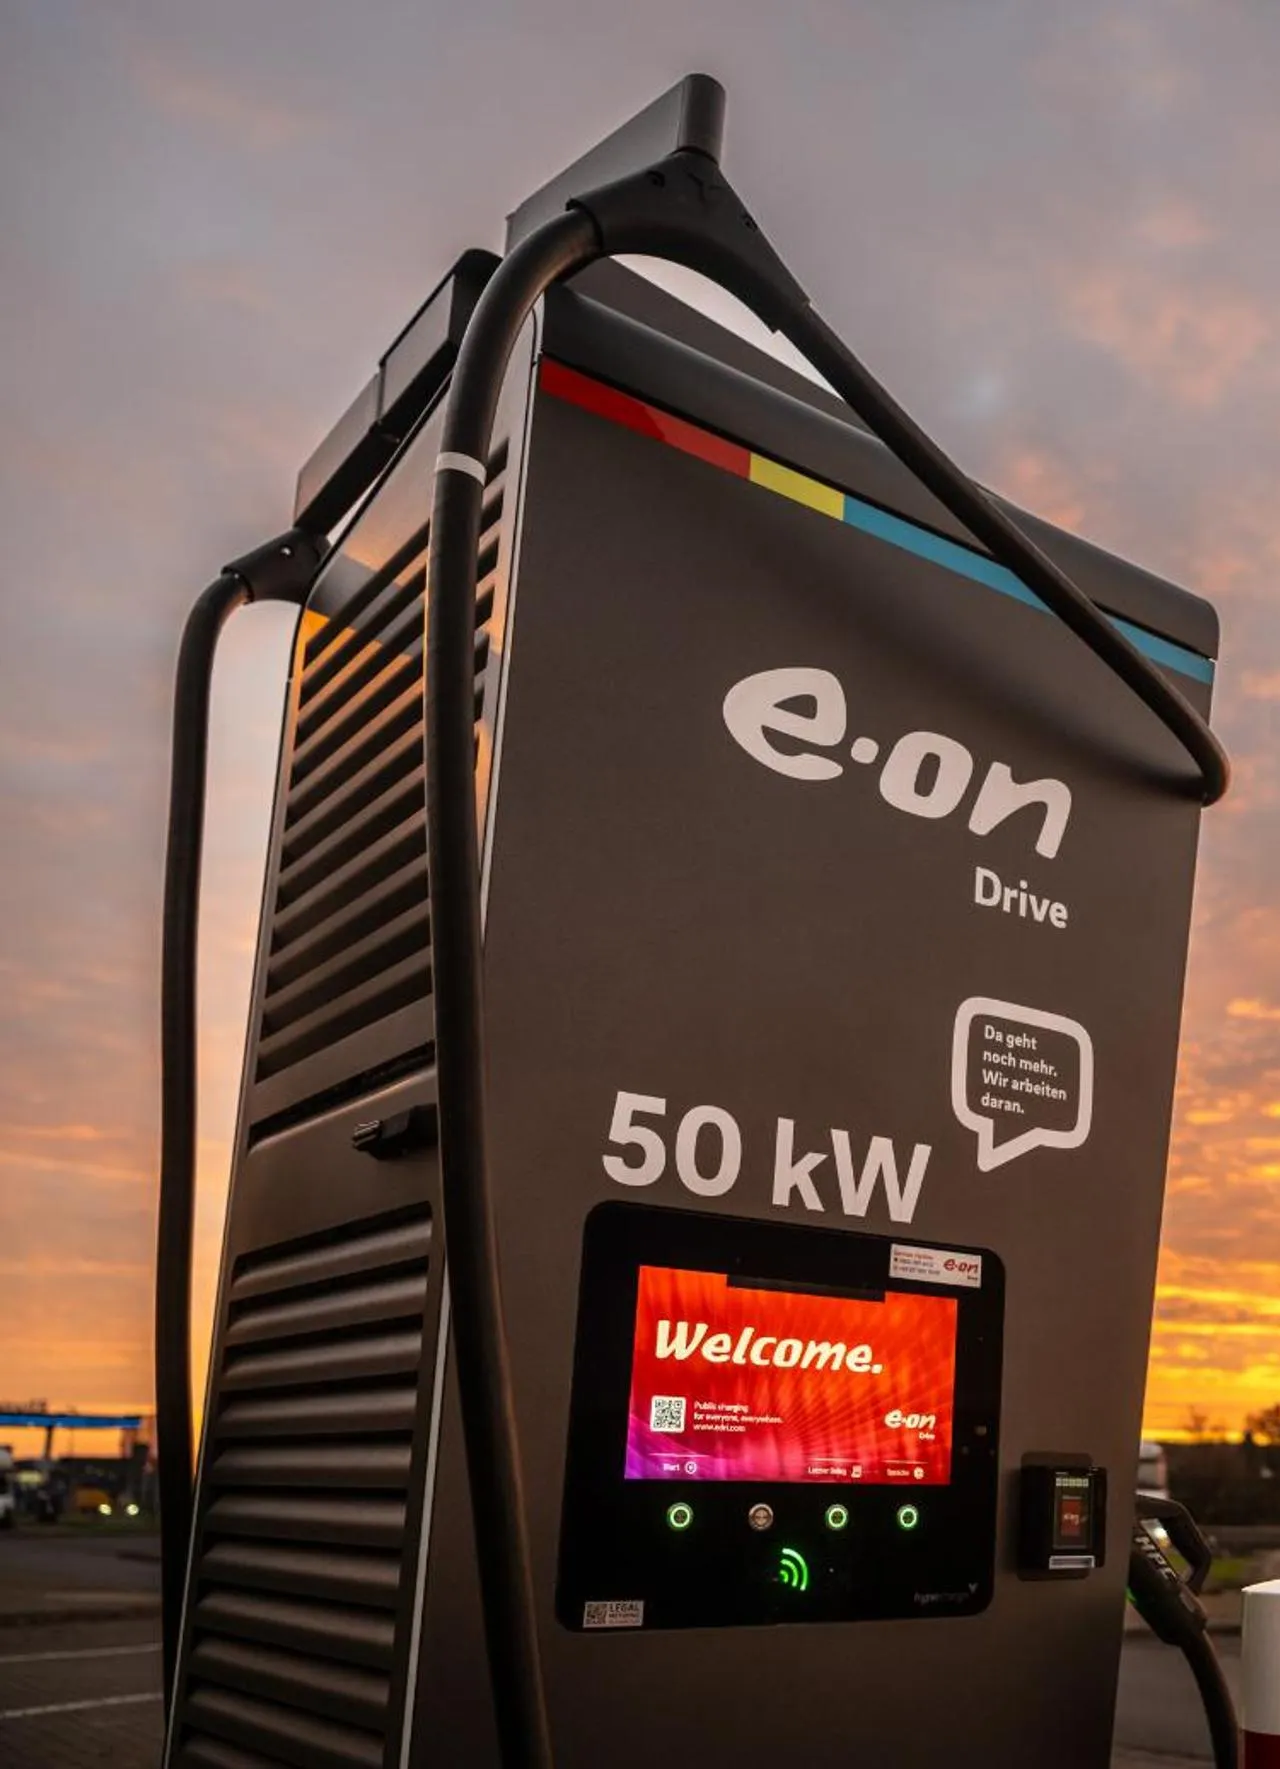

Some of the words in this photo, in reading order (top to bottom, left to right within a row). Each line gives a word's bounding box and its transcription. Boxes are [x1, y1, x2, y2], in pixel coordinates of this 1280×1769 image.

[974, 866, 1069, 929] Drive
[984, 1024, 1003, 1043] Da
[1006, 1033, 1038, 1050] geht
[983, 1050, 1016, 1068] noch
[1020, 1059, 1058, 1077] mehr.
[982, 1068, 1008, 1088] Wir
[1011, 1078, 1067, 1101] arbeiten
[981, 1092, 1024, 1114] daran.
[602, 1090, 742, 1197] 50
[772, 1117, 932, 1224] kW
[655, 1319, 883, 1374] Welcome.
